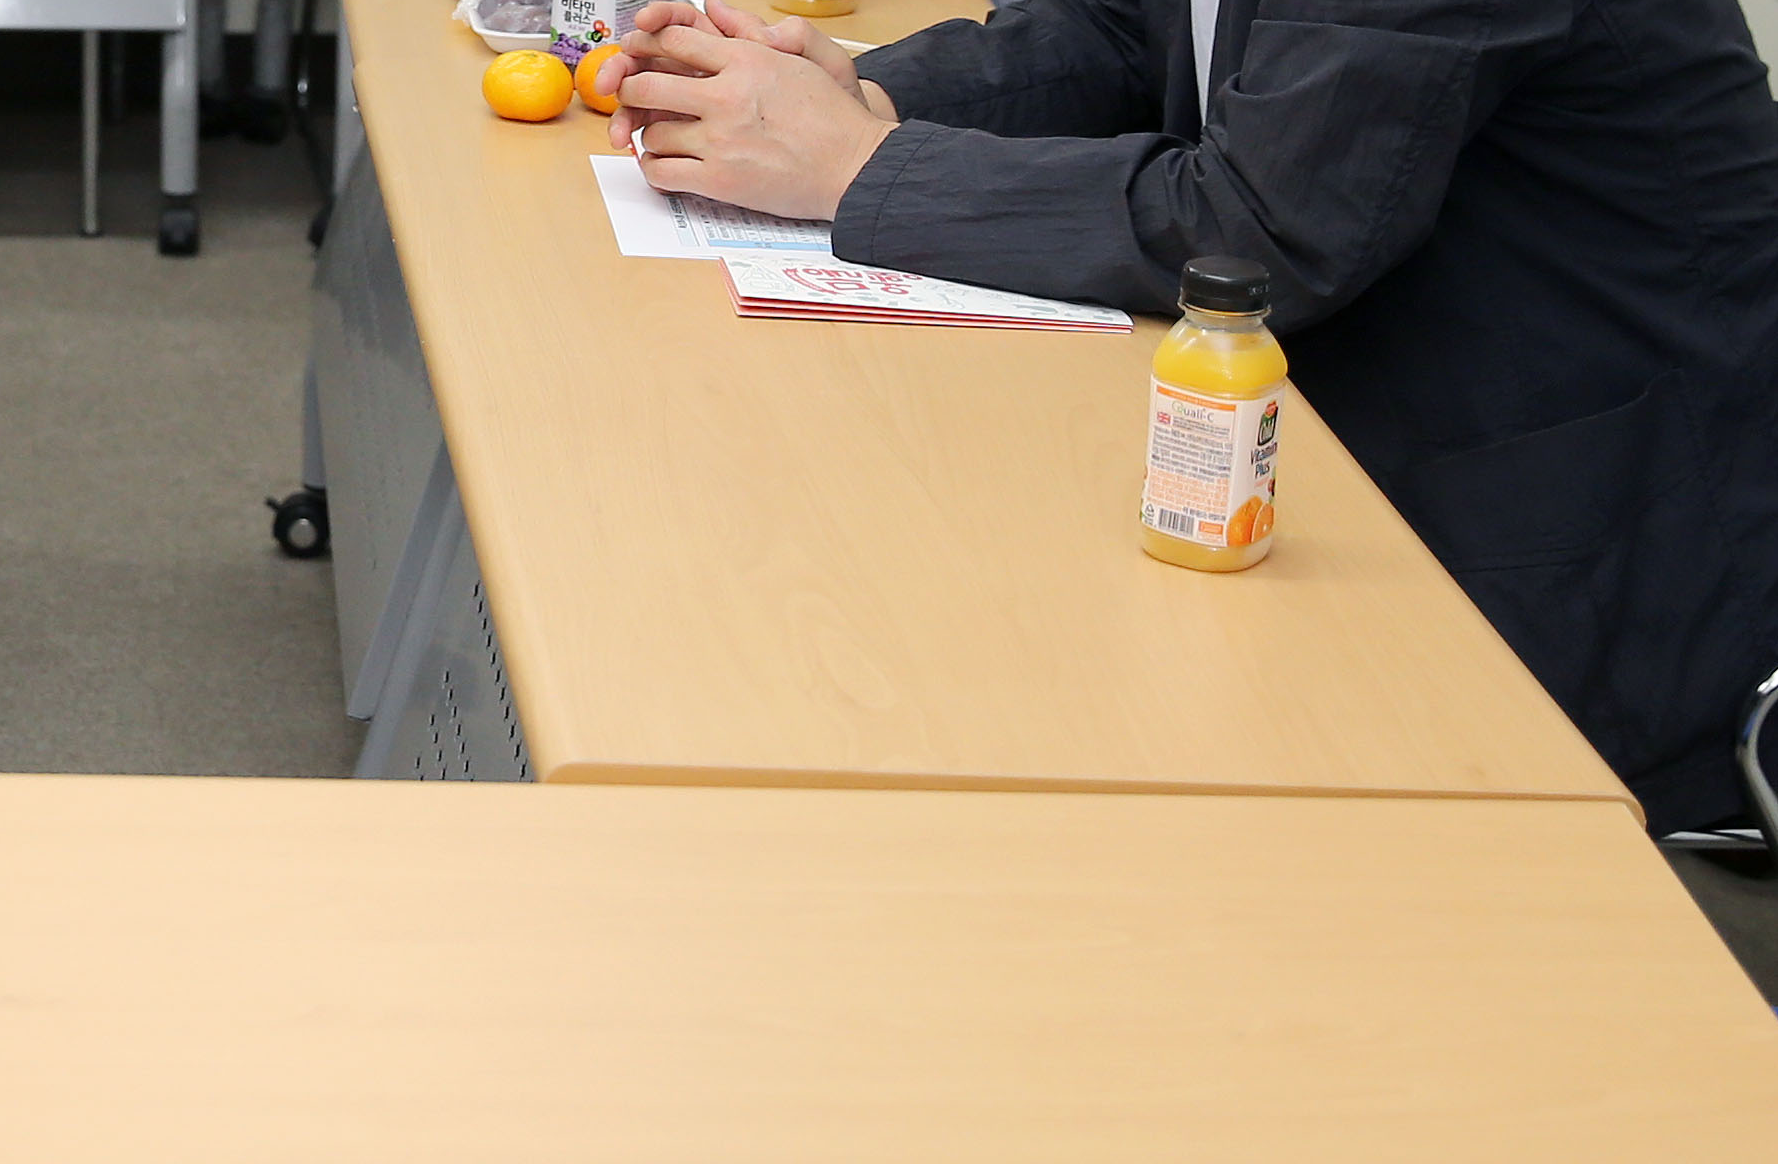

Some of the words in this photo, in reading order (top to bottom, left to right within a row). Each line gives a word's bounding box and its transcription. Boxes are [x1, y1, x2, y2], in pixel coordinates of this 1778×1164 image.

[564, 10, 591, 25] 플러스
[1250, 441, 1278, 466] Vitamin
[1254, 461, 1270, 479] Plus
